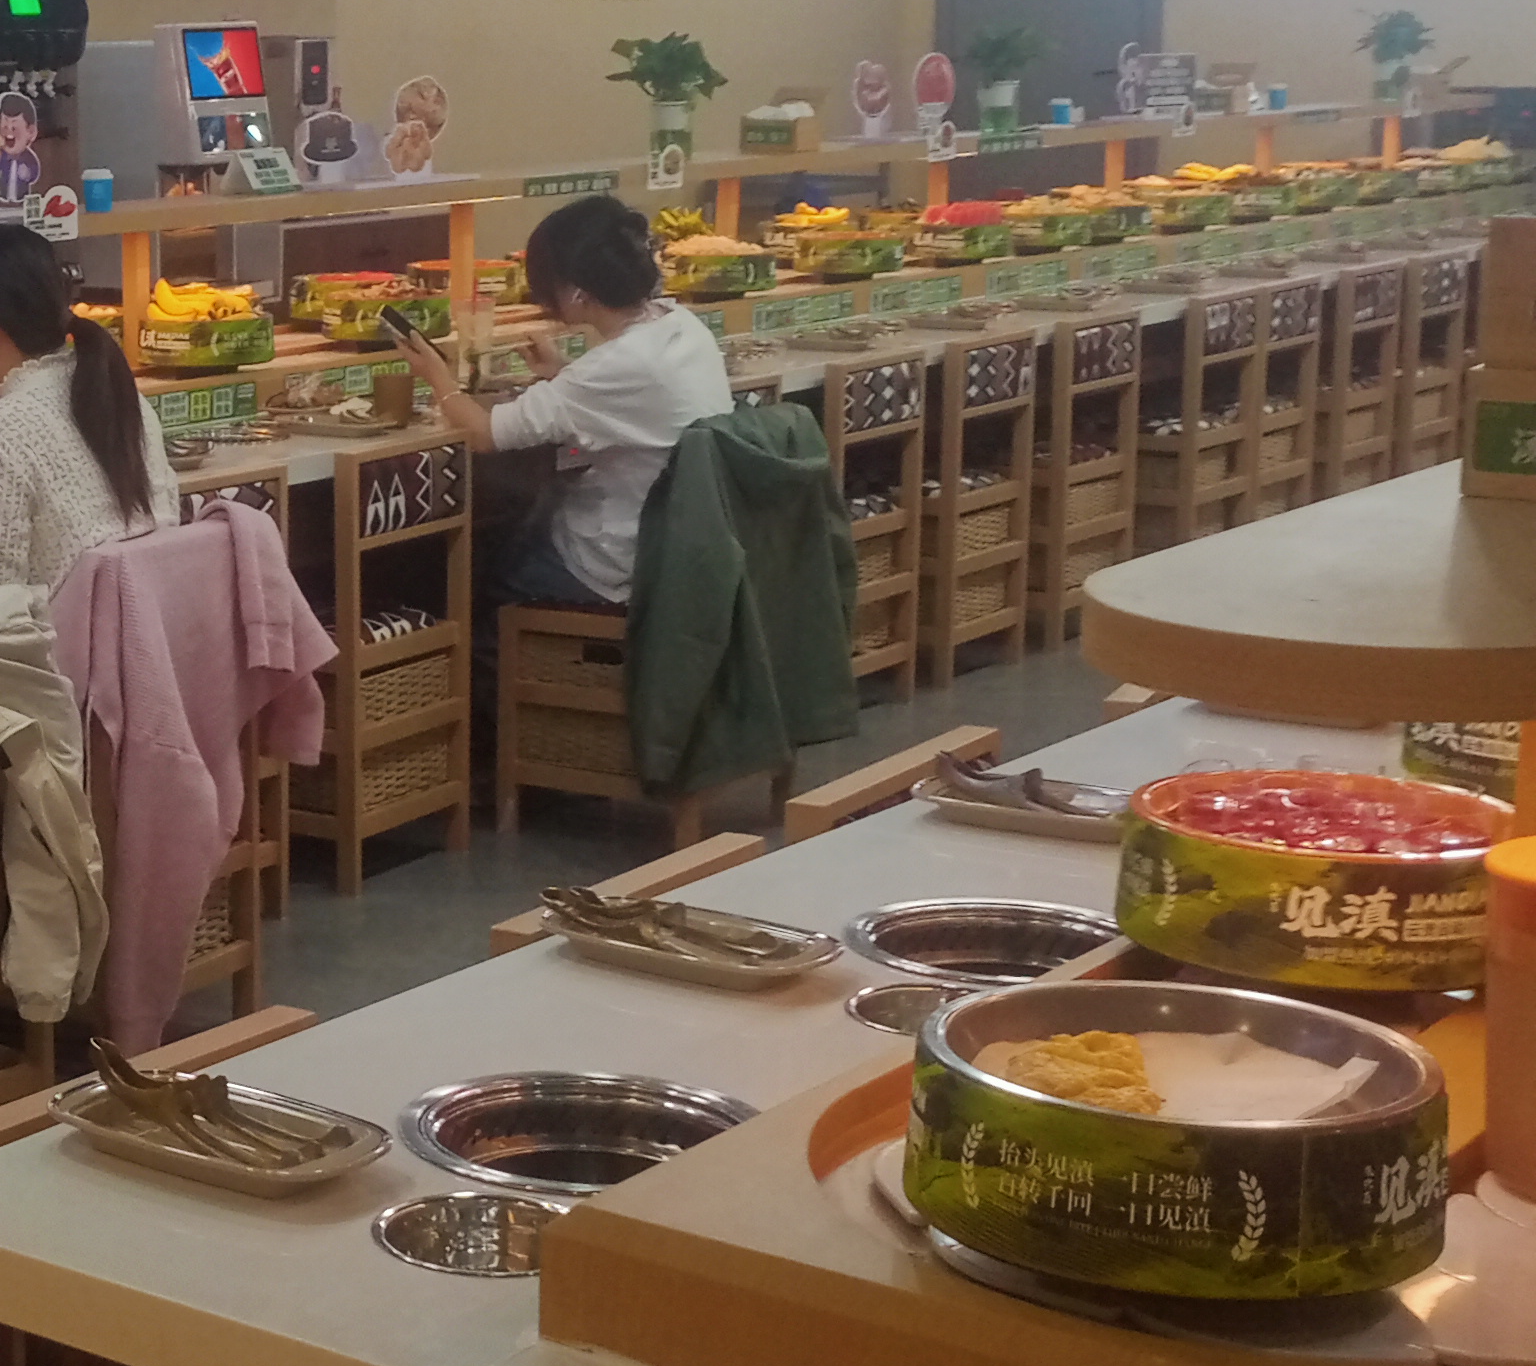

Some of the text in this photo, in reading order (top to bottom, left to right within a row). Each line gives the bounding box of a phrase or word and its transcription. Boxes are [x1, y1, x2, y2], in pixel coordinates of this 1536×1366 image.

[1279, 885, 1399, 942] 见滇
[998, 1138, 1095, 1186] 抬头见滇
[998, 1172, 1093, 1217] 百转千回
